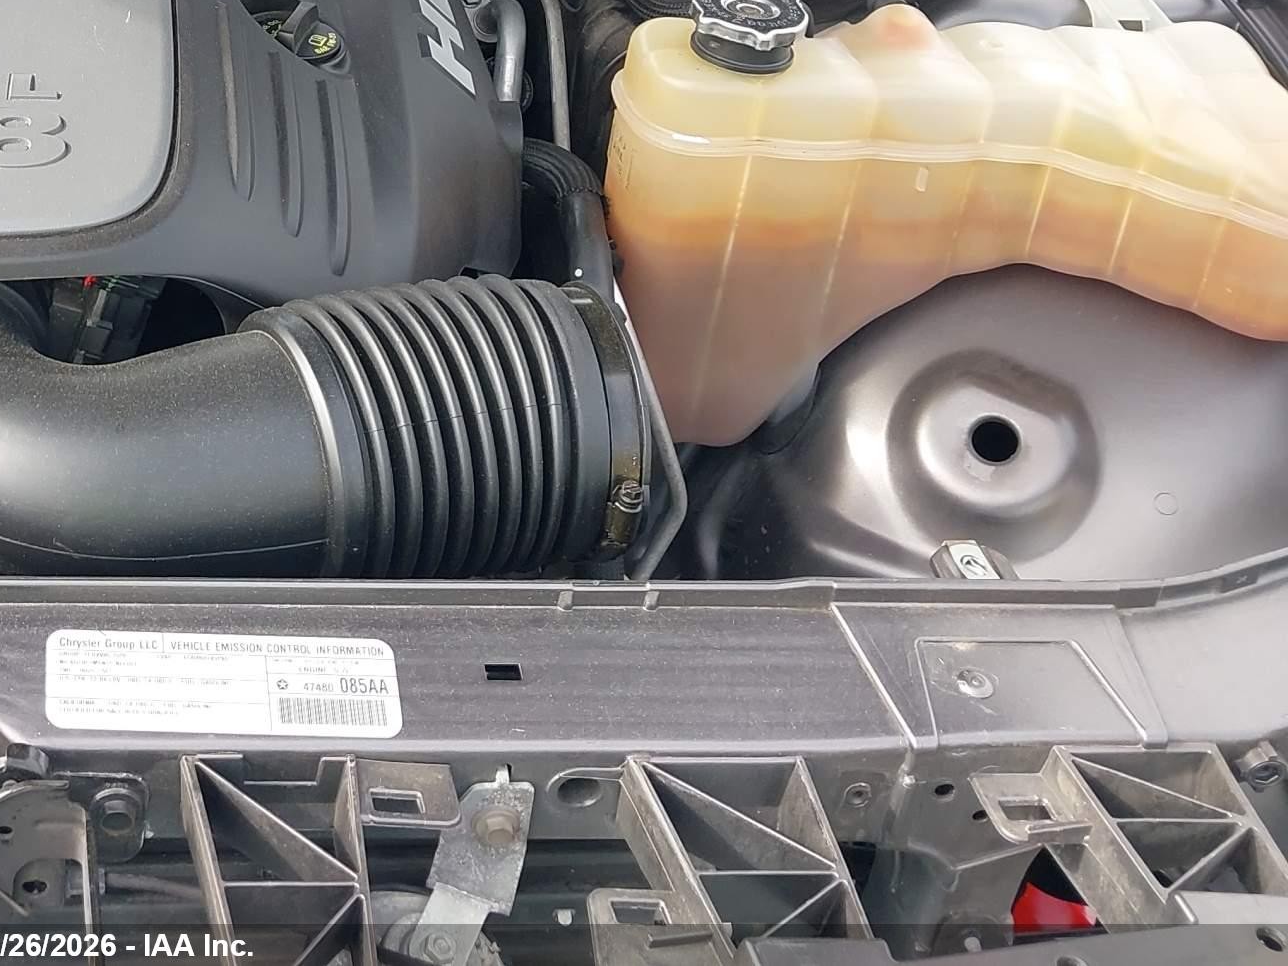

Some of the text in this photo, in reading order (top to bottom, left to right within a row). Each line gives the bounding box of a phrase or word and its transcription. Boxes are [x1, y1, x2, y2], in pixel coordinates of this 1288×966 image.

[6, 73, 63, 101] L
[59, 637, 158, 650] Chrysler Group LLC
[170, 641, 384, 656] VEHICLE EMISSION CONTROL INFORMATION
[339, 677, 389, 694] 085AA
